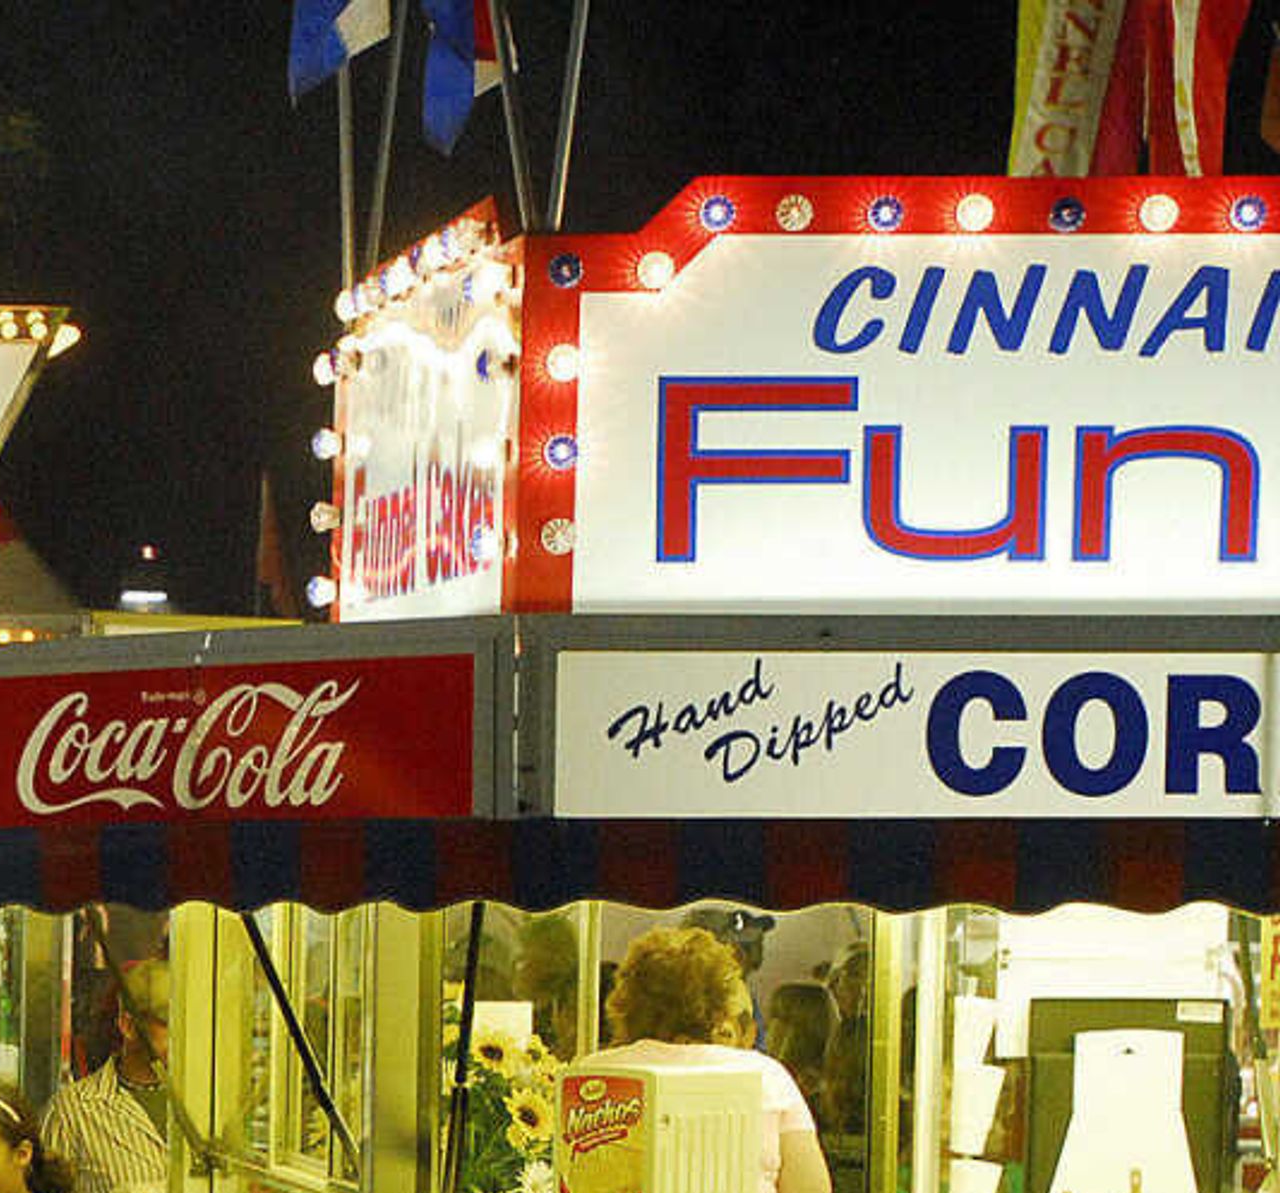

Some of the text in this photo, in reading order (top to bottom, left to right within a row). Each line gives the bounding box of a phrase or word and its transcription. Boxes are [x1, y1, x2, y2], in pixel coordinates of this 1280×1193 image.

[656, 375, 1261, 562] Fun
[17, 679, 361, 814] Coca-Cola
[608, 658, 775, 760] Hand
[705, 662, 915, 783] Dipped
[926, 669, 1263, 798] COR
[566, 1096, 642, 1134] Nachos
